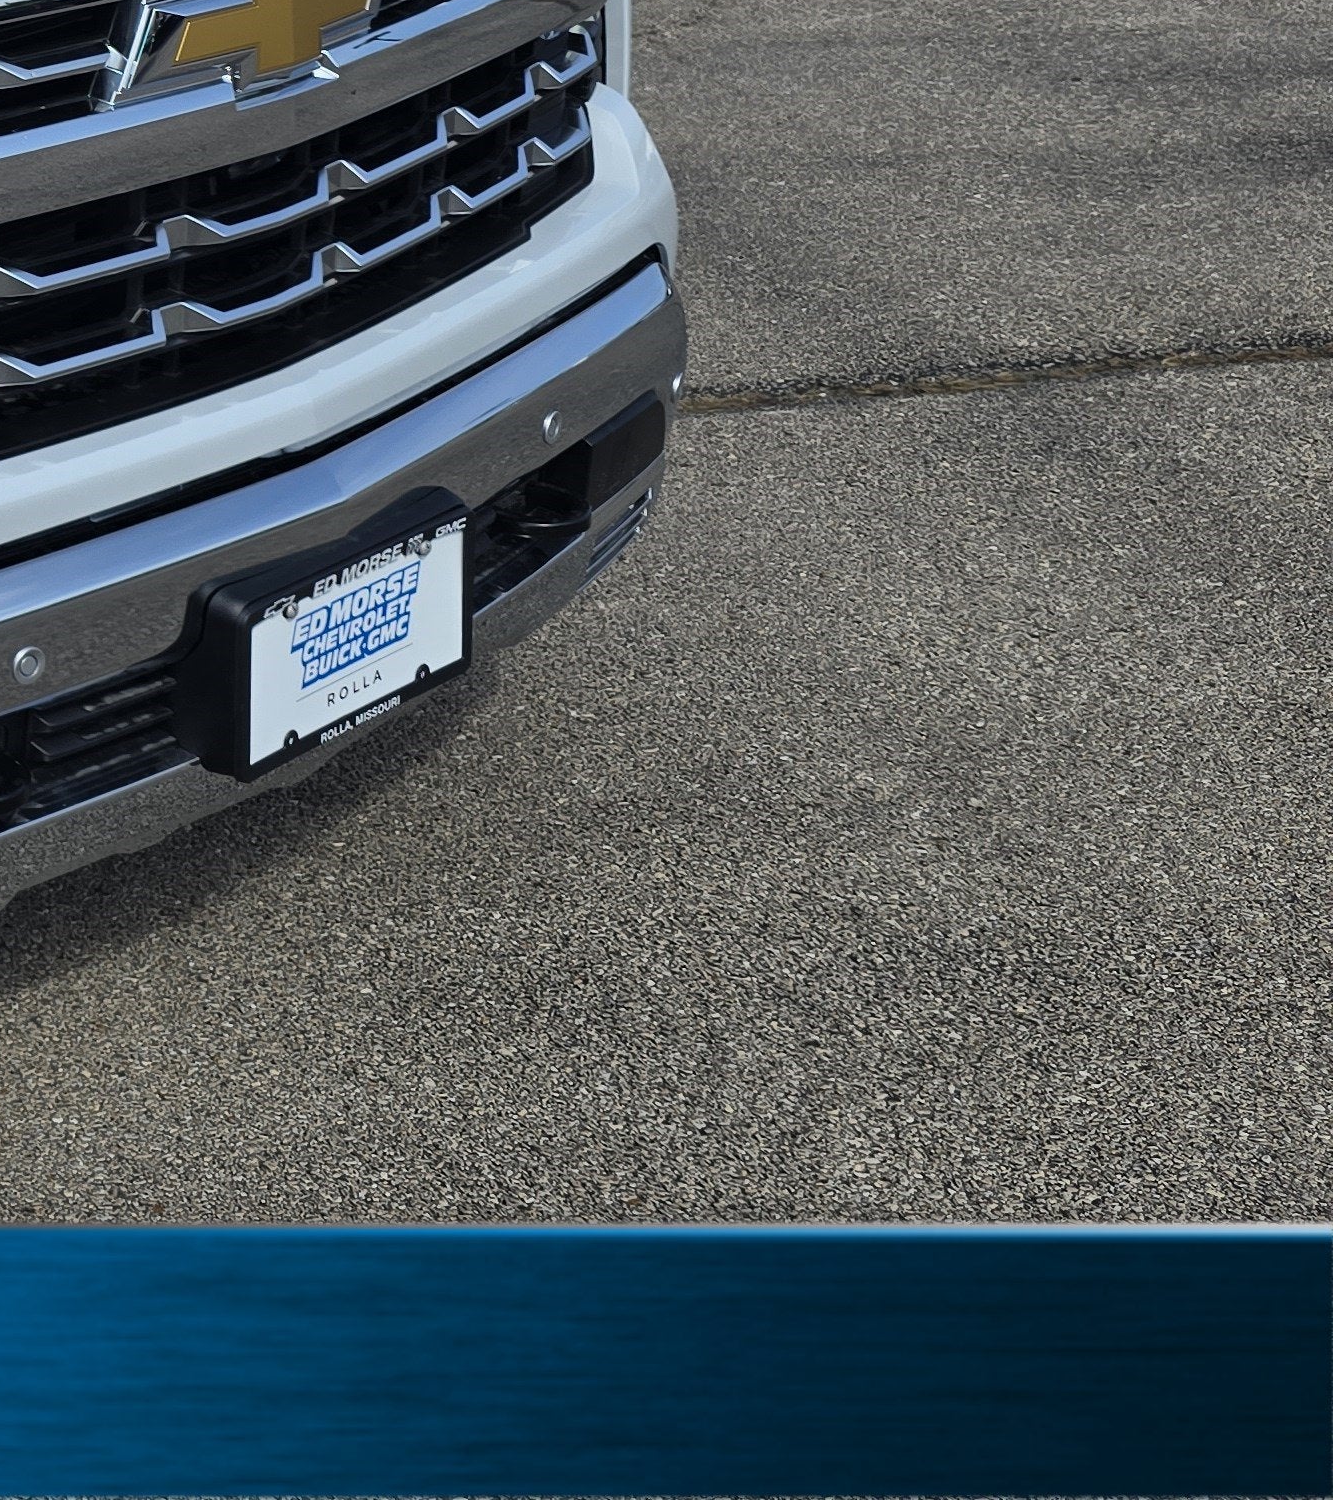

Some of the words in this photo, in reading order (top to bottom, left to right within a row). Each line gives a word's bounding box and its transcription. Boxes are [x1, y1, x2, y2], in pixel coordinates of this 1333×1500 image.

[313, 573, 338, 598] ED
[340, 543, 404, 586] MORSE
[435, 517, 467, 538] GMC
[293, 607, 328, 648] ED
[330, 564, 420, 628] MORSE
[302, 595, 411, 664] CHEVROLET
[320, 719, 354, 745] ROLLA,
[355, 695, 401, 727] MISSOURI
[327, 669, 383, 707] ROLLA
